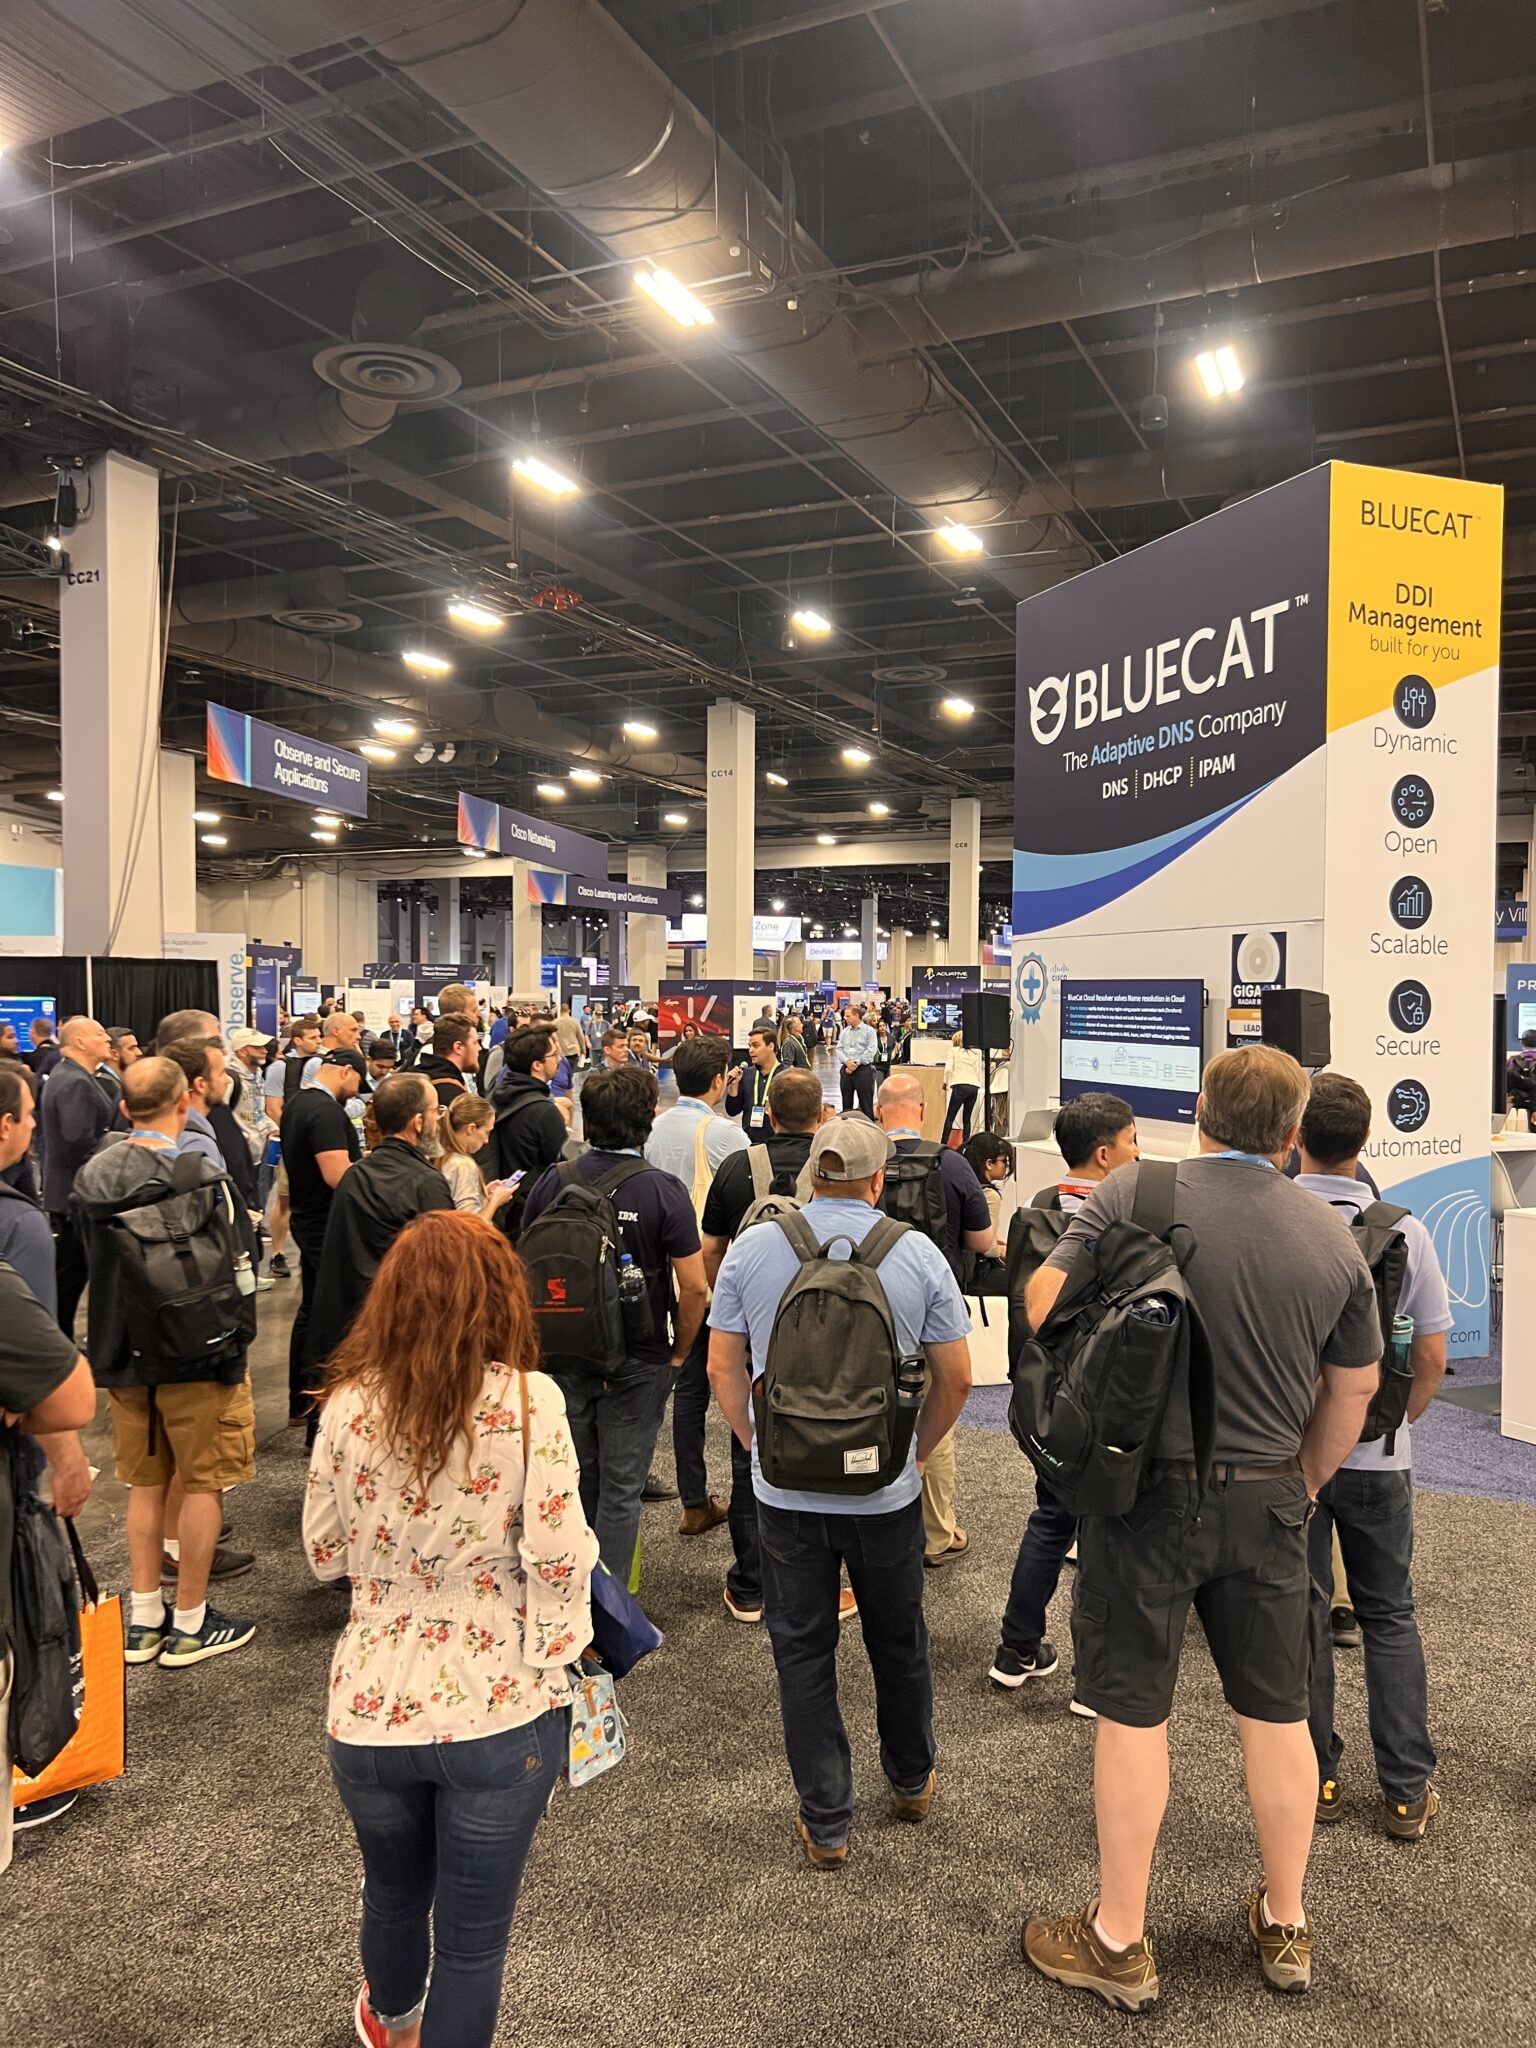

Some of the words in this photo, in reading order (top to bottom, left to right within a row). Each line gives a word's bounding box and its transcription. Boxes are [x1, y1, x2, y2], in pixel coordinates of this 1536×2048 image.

[1361, 499, 1473, 539] BLUECAT
[67, 569, 100, 586] CC21
[1396, 582, 1433, 608] DDI
[1348, 601, 1482, 638] Management
[1370, 634, 1403, 655] built
[1407, 639, 1429, 657] for
[1432, 645, 1460, 662] you
[1074, 599, 1290, 730] BLUECAT
[1062, 751, 1089, 773] The
[1091, 734, 1155, 768] Adaptive
[1159, 719, 1194, 749] DNS
[1198, 700, 1288, 738] Company
[1373, 726, 1459, 755] Dynamic
[273, 738, 314, 767] Observe
[314, 756, 331, 773] and
[331, 758, 361, 782] Secure
[711, 769, 733, 779] CC14
[273, 762, 329, 794] Applications
[1102, 778, 1129, 799] DNS
[1142, 765, 1183, 791] DHCP
[1199, 753, 1236, 778] IPAM
[511, 823, 527, 841] Cisco
[527, 828, 556, 852] Networking
[1384, 830, 1437, 858] Open
[577, 885, 593, 897] Cisco
[594, 887, 617, 902] Learning
[617, 891, 627, 901] and
[627, 893, 659, 905] Certifications
[1370, 932, 1448, 955] Scalable
[1243, 1023, 1261, 1033] LEAD
[1375, 1034, 1441, 1056] Secure
[618, 1210, 639, 1222] IBM
